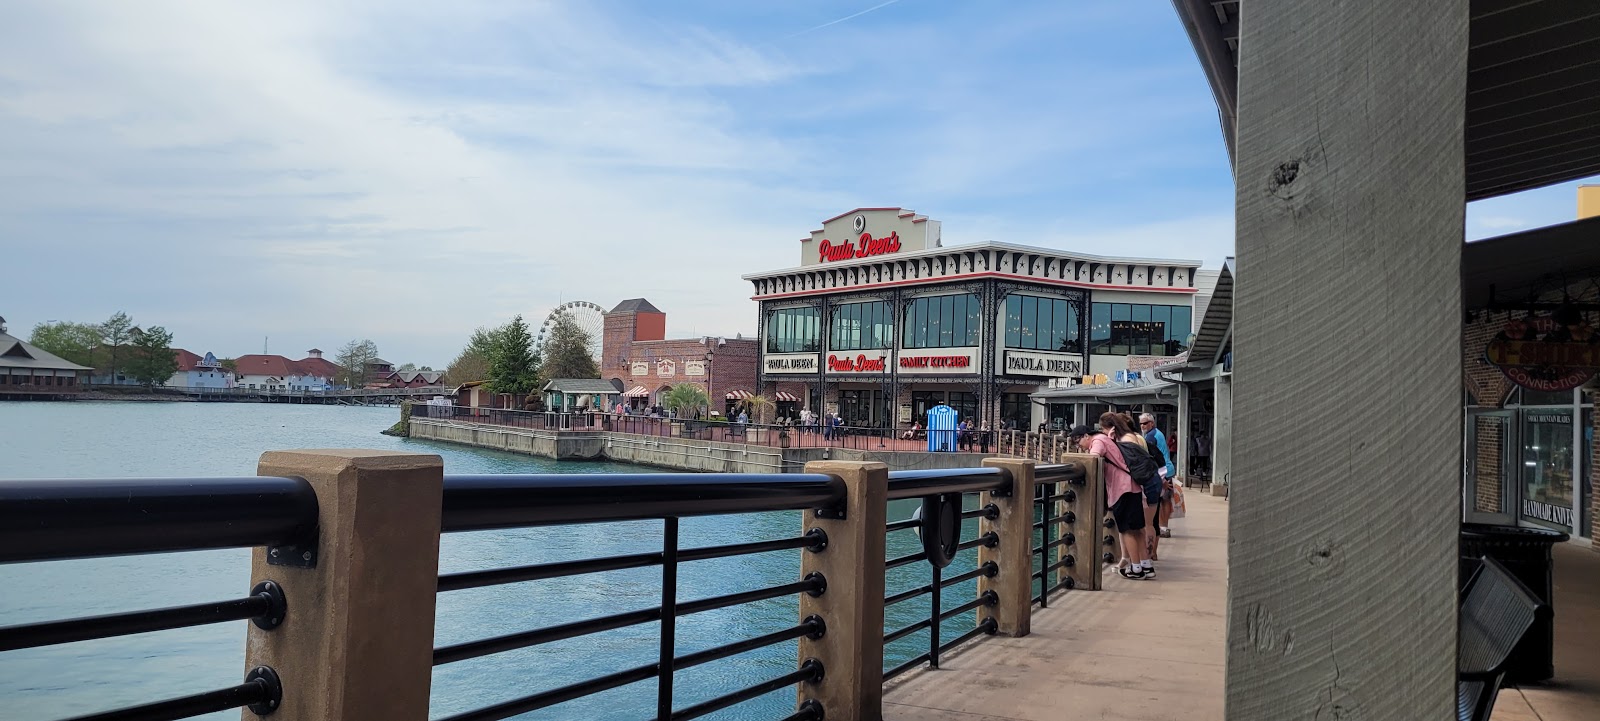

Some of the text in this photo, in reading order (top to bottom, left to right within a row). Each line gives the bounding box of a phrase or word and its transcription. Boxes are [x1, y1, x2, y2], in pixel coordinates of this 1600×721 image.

[819, 231, 901, 263] Paula Deen's
[1535, 318, 1561, 331] THE
[768, 358, 790, 370] PAULA
[790, 358, 814, 370] DEEN
[828, 353, 887, 372] Paula Deen's
[899, 355, 971, 368] FAMILY KITCHEN
[1008, 356, 1081, 373] PAULA DEEN
[1508, 367, 1587, 389] CONNECTION
[1556, 415, 1571, 424] BLADES
[1523, 499, 1574, 528] HANDMADE KNIVES
